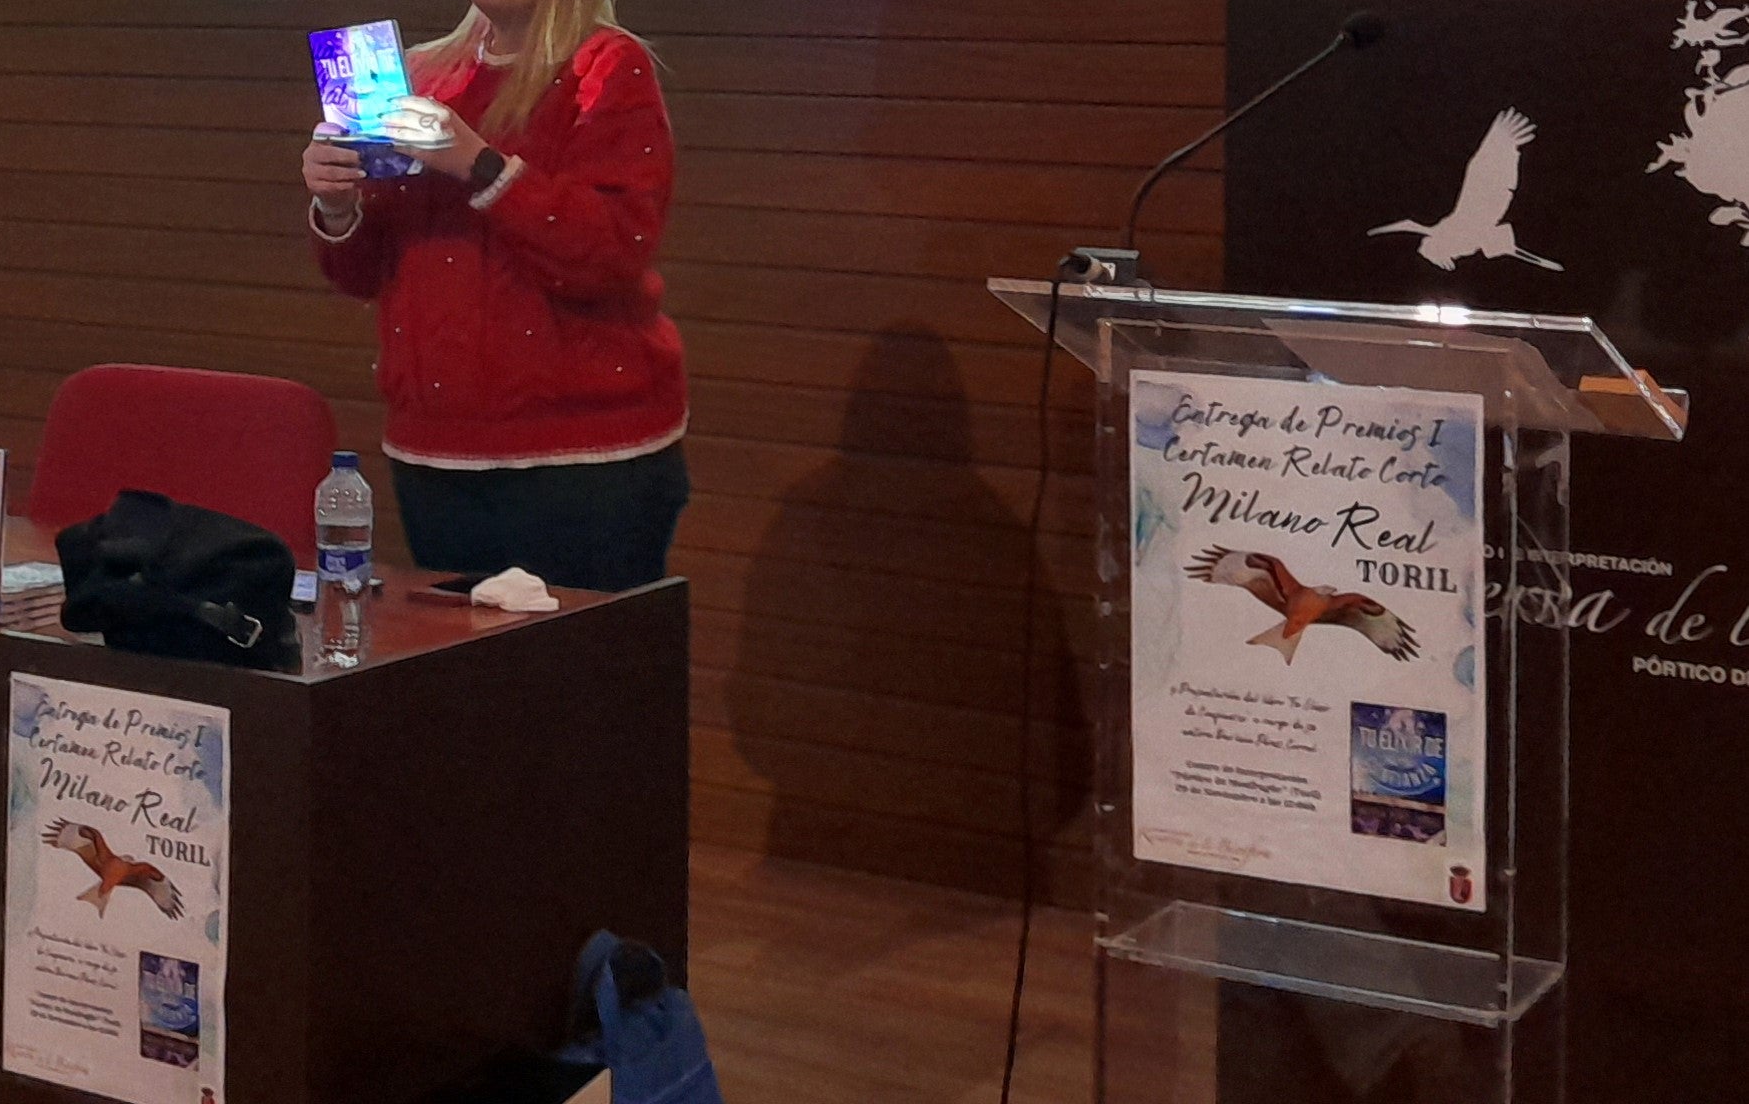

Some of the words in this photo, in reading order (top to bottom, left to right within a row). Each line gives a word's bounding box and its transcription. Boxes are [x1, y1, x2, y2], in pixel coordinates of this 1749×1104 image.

[1171, 394, 1271, 438] Entrega
[1279, 405, 1310, 434] de
[1315, 404, 1422, 452] Premios
[1428, 418, 1445, 447] I
[1163, 434, 1272, 472] Certamen
[1281, 445, 1373, 482] Relato
[1378, 455, 1448, 489] Corto
[1181, 471, 1328, 535] Milano
[1330, 500, 1438, 554] Real
[1355, 558, 1458, 594] TORIL
[1645, 563, 1729, 645] de
[1633, 653, 1727, 684] PÓRTICO
[40, 757, 130, 813] Milano
[130, 787, 200, 834] Real
[145, 833, 211, 868] TORIL
